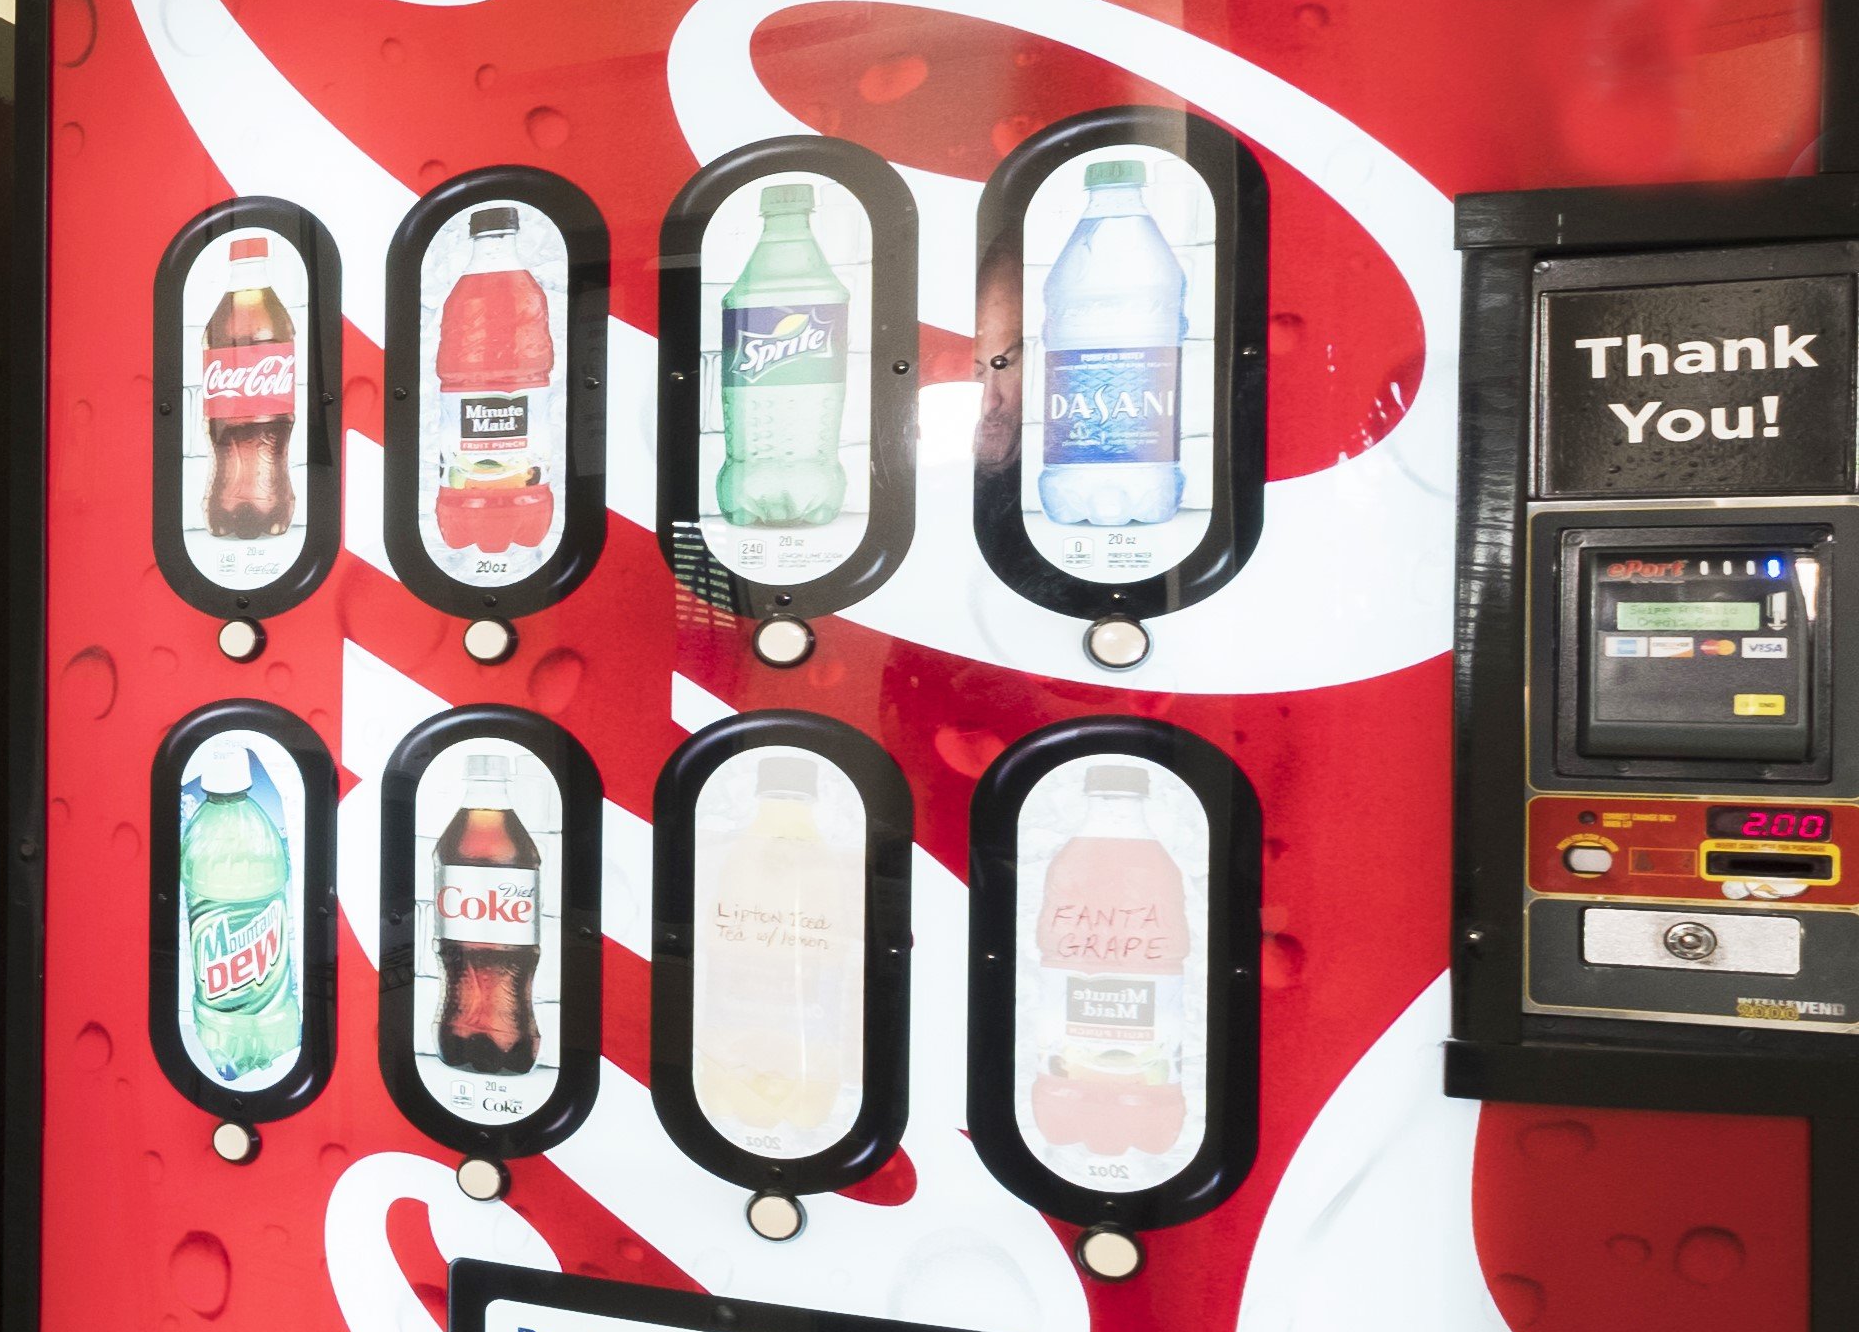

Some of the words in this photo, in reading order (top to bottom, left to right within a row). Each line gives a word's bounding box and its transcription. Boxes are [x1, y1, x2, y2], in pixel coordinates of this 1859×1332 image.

[739, 325, 825, 374] Sprite
[1575, 325, 1819, 381] Thank
[203, 354, 296, 400] Coca-Cola
[465, 405, 524, 419] Minute
[1050, 383, 1175, 426] DASANI
[471, 418, 516, 433] Maid
[1608, 395, 1783, 445] You!
[463, 441, 489, 450] FRUIT
[491, 439, 526, 449] PUNCH
[741, 543, 763, 555] 240
[778, 536, 792, 547] 20
[1108, 533, 1123, 545] 20
[475, 560, 508, 574] 20oz
[1606, 560, 1685, 579] ePort
[1748, 643, 1783, 653] VISA
[1741, 811, 1826, 840] 2.00
[498, 882, 535, 899] Diet
[436, 885, 533, 924] Coke
[717, 902, 783, 924] Lipton
[1051, 903, 1160, 928] FANTA
[202, 904, 278, 963] Mountain
[715, 923, 746, 942] Tea
[755, 927, 779, 948] w/
[781, 928, 830, 951] lemon
[1055, 932, 1169, 960] GRAPE
[485, 1080, 497, 1092] 20
[482, 1097, 524, 1114] Coke
